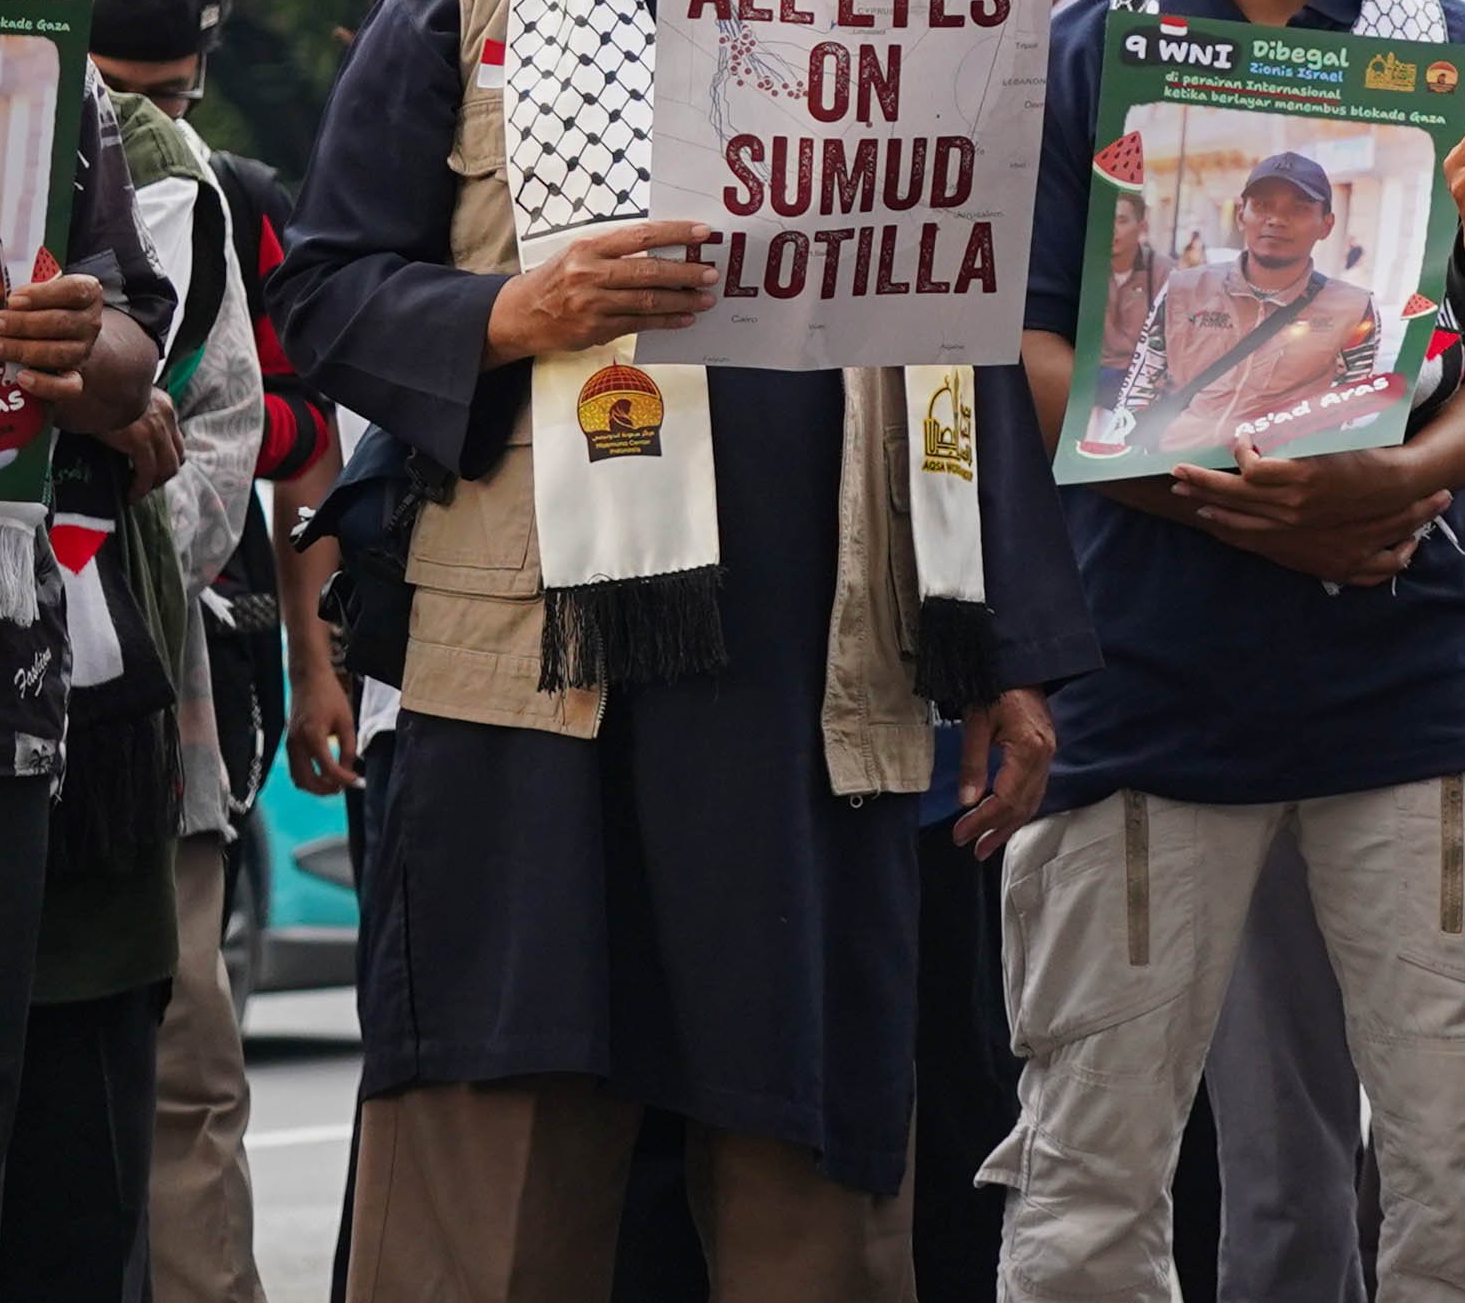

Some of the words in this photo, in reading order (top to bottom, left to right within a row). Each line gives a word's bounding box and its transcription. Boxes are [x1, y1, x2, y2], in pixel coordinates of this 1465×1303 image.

[36, 20, 71, 33] Gaza
[1125, 34, 1147, 58] 9
[1158, 39, 1234, 69] WNI
[1252, 40, 1350, 70] Dibegal
[808, 41, 902, 123] ON
[1165, 71, 1179, 83] di
[1182, 74, 1243, 90] perairan
[1246, 79, 1341, 100] Internasional
[1250, 62, 1293, 78] Zionis
[1296, 68, 1344, 83] Israel
[1164, 85, 1208, 101] ketika
[1210, 91, 1272, 109] berlayar
[1274, 99, 1347, 117] menembus
[1350, 105, 1405, 122] blokade
[1409, 111, 1447, 125] Gaza
[723, 133, 976, 218] SUMUD
[685, 222, 998, 300] FLOTILLA
[1235, 400, 1311, 437] As'ad
[1320, 376, 1389, 409] Aras
[14, 647, 52, 699] Fashion
